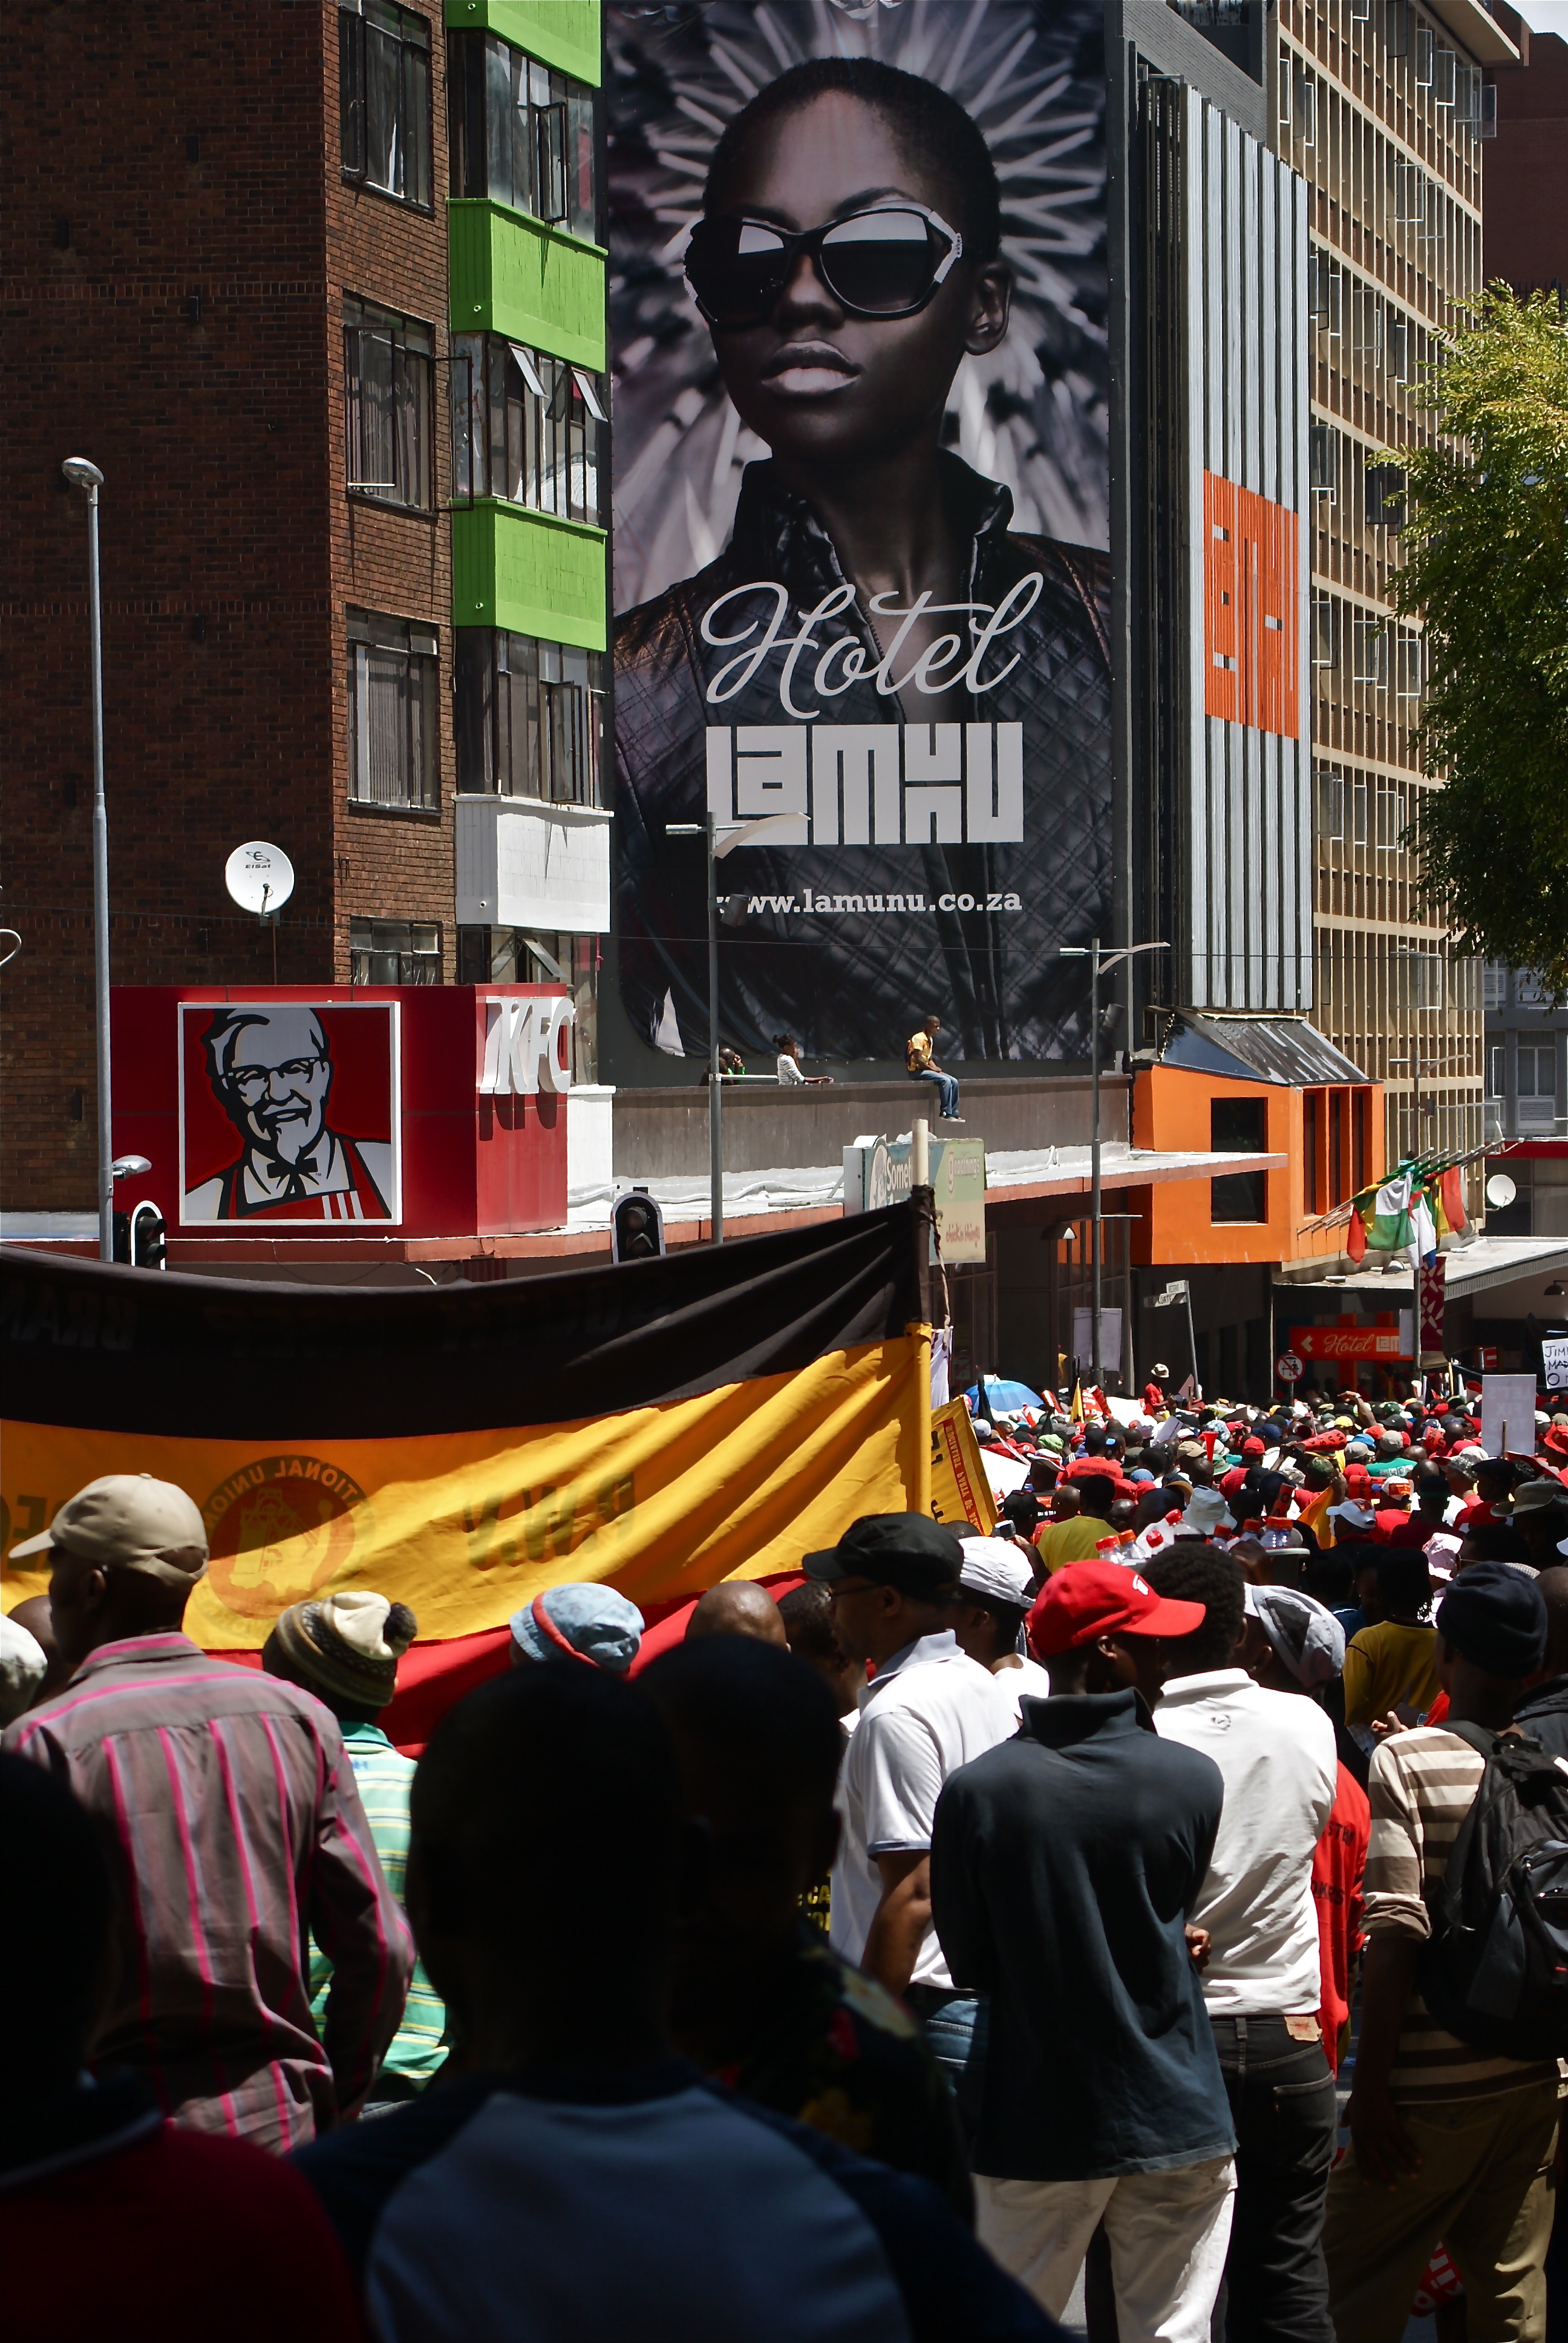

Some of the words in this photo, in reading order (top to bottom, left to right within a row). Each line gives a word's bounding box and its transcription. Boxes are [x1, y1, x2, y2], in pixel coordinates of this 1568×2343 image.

[701, 572, 1044, 720] Hotel
[481, 997, 574, 1094] KFC
[886, 1155, 913, 1191] Somet
[1324, 1334, 1375, 1355] Hotel
